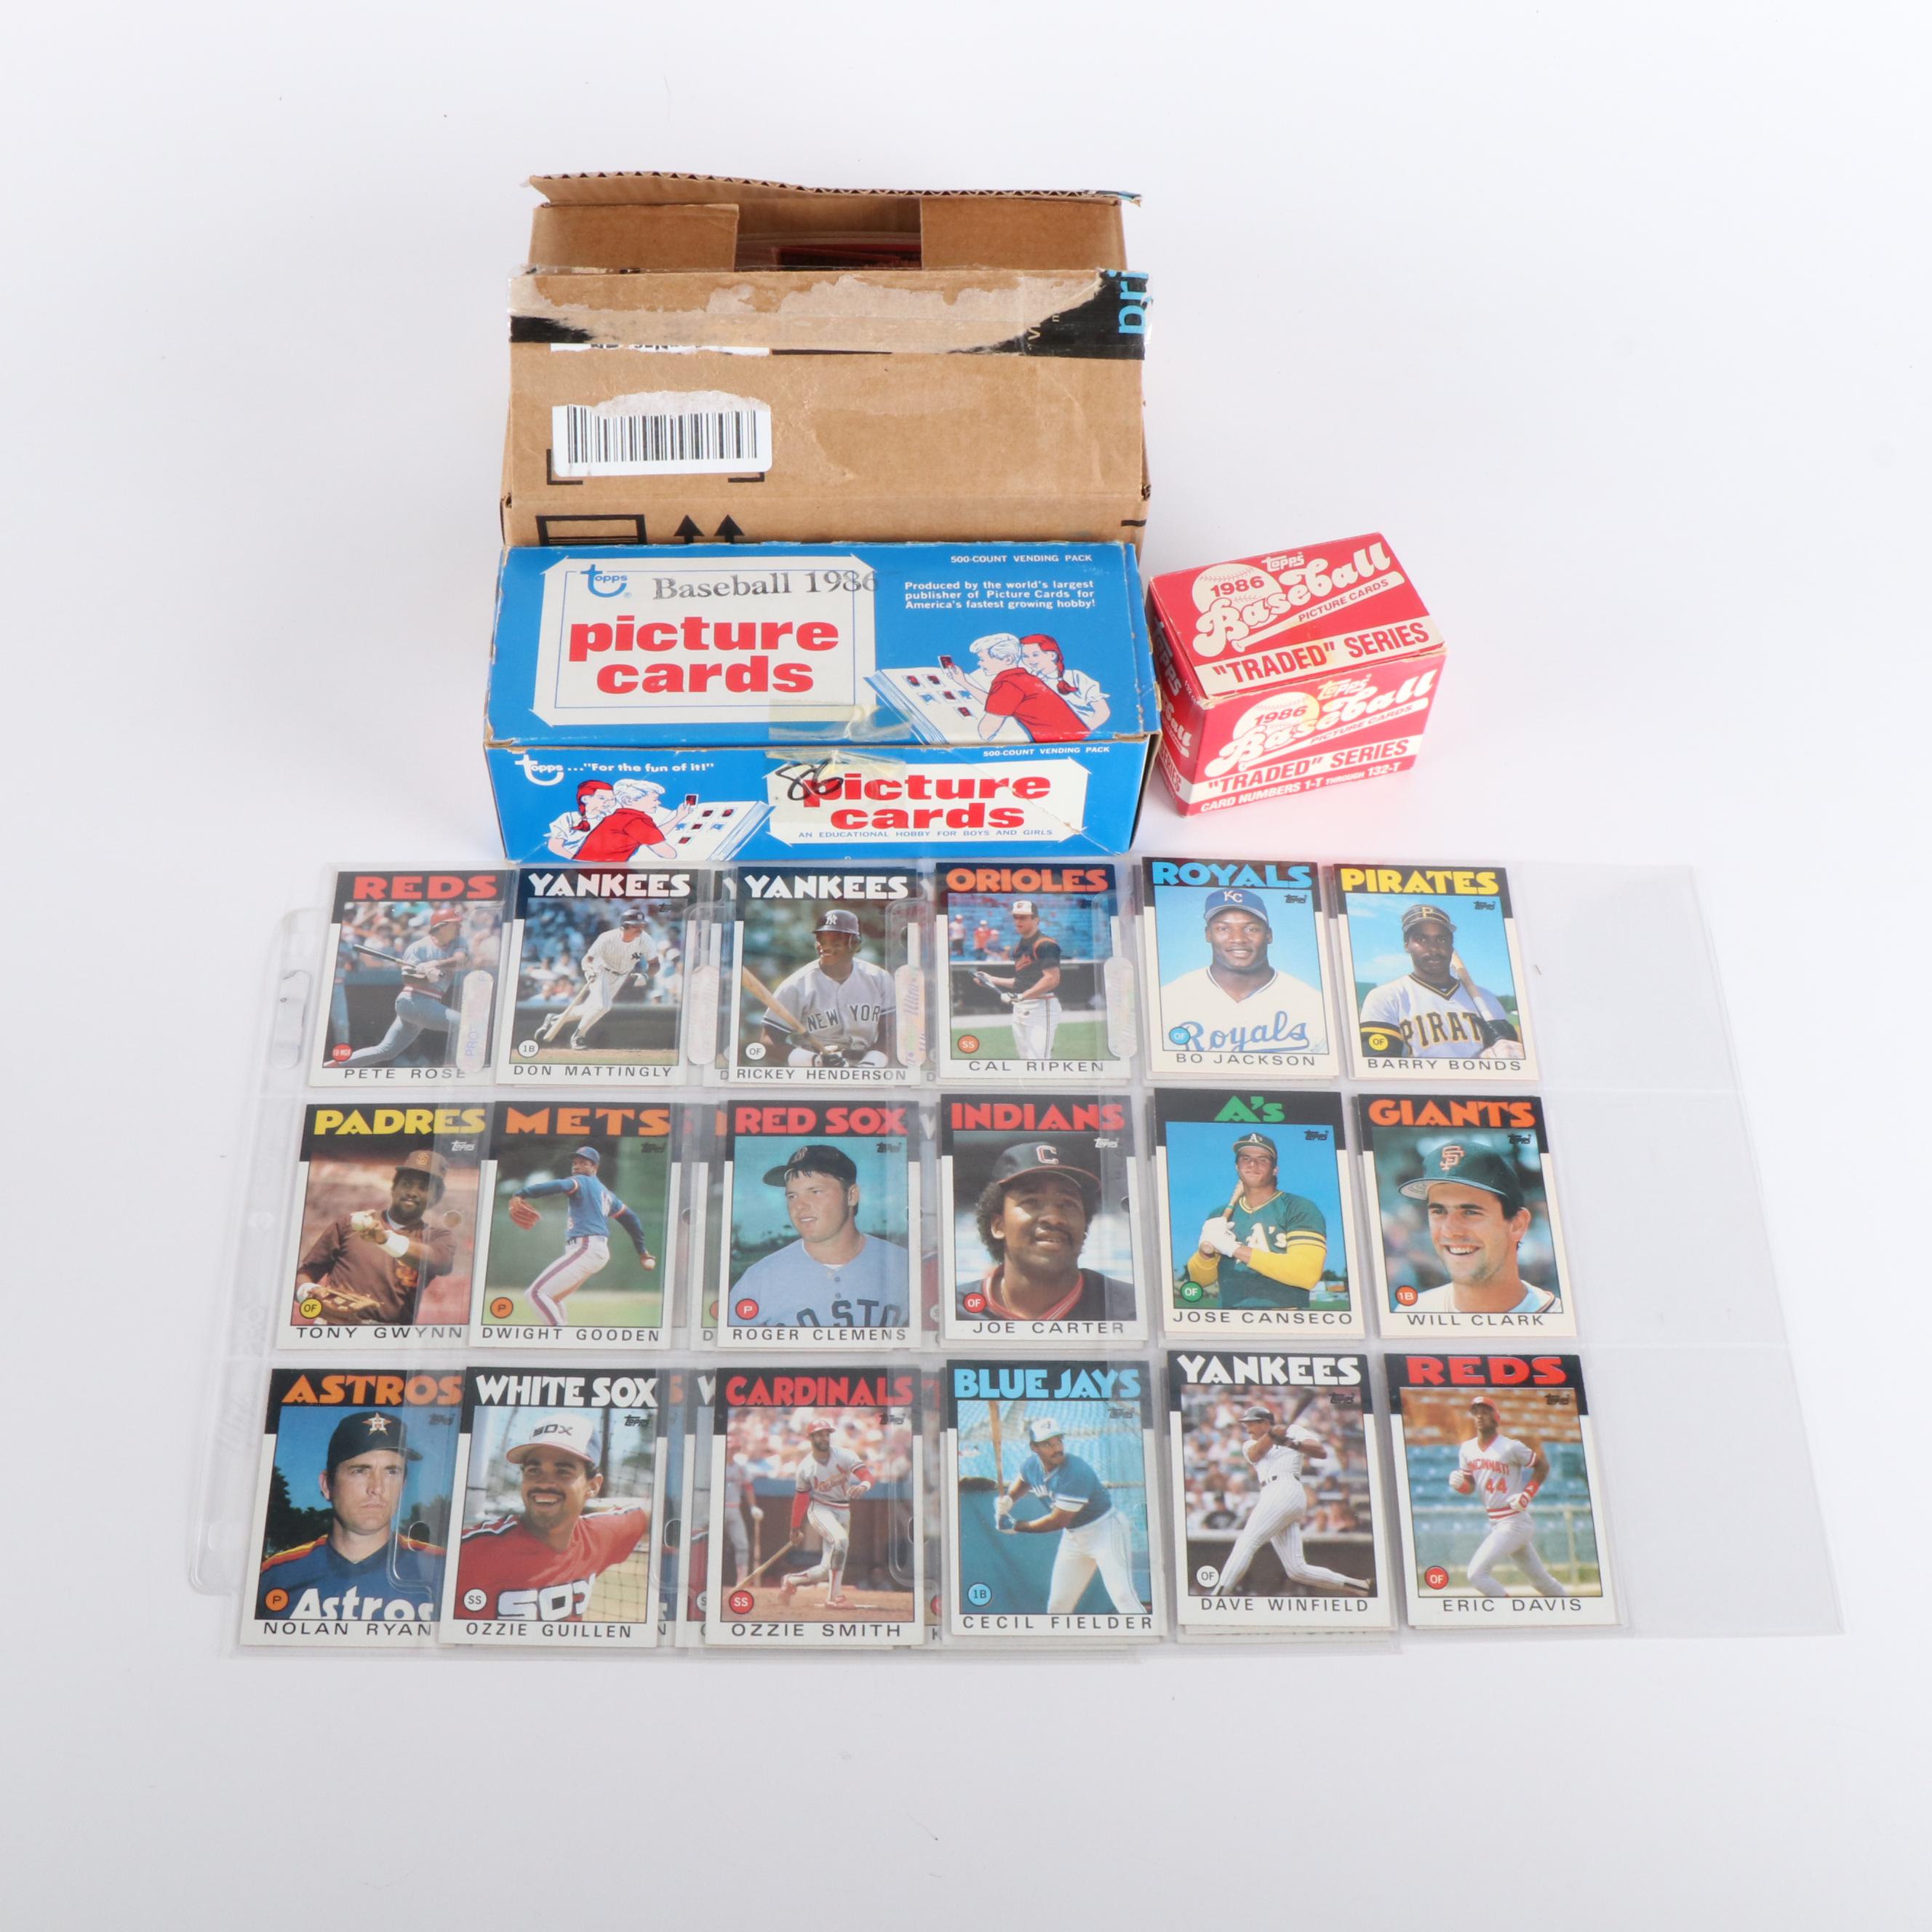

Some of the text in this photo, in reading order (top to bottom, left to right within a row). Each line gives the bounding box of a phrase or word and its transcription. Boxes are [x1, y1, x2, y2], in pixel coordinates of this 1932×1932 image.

[951, 555, 1007, 563] 500-COUNT
[652, 569, 879, 600] Baseball 1986
[905, 581, 960, 590] Produced
[965, 581, 978, 590] by
[983, 581, 1002, 589] the
[1053, 580, 1094, 590] largest
[1210, 575, 1264, 597] 1986
[905, 590, 1094, 601] publisher of Picture Cards for
[1192, 542, 1391, 658] Baseball
[1298, 579, 1389, 623] PICTURE CARDS
[905, 599, 1095, 610] America's fastest growing hobby!
[569, 615, 839, 662] picture
[1213, 641, 1334, 683] "TRADED"
[1344, 623, 1429, 658] SERIES
[596, 655, 814, 694] cards
[1204, 668, 1437, 778] Baseball
[1254, 706, 1307, 726] 1986
[1310, 705, 1413, 744] PICTURE CARDS
[983, 746, 1110, 757] 500-COUNT VENDING PACK
[618, 763, 642, 772] the
[645, 763, 668, 773] fun
[671, 763, 687, 772] of
[1209, 758, 1322, 793] "TRADED"
[1330, 740, 1409, 768] SERIES
[775, 759, 844, 800] 86
[802, 773, 1051, 807] picture
[1200, 762, 1402, 813] CARD NUMBERS 1-T THROUGH 132-T
[830, 802, 1025, 830] cards
[946, 868, 1108, 893] ORIOLES
[1151, 862, 1312, 888] ROYALS
[1341, 869, 1498, 894] PIRATES
[353, 875, 498, 901] REDS
[527, 874, 690, 897] YANKEES
[744, 875, 908, 899] YANKEES
[807, 1009, 839, 1032] NEW
[1186, 1010, 1309, 1052] Royals
[749, 1047, 762, 1055] OF
[962, 1040, 975, 1048] SS
[968, 1061, 1103, 1072] CAL RIPKEN
[1176, 1053, 1315, 1066] BO JACKSON
[1368, 1059, 1522, 1071] BARRY BONDS
[345, 1068, 467, 1079] PETE ROSE
[514, 1066, 671, 1077] DON MATTINGLY
[736, 1068, 906, 1080] RICKEY HENDERSON
[505, 1107, 671, 1135] METS
[735, 1107, 816, 1134] RED
[825, 1107, 907, 1135] SOX
[951, 1103, 1125, 1130] INDIANS
[1368, 1101, 1535, 1127] GIANTS
[314, 1109, 487, 1135] PADRES
[1037, 1145, 1059, 1164] C
[1184, 1288, 1198, 1296] OF
[1399, 1293, 1413, 1301] 1B
[303, 1304, 317, 1312] OF
[498, 1304, 506, 1312] P
[967, 1298, 981, 1307] OF
[744, 1306, 752, 1314] P
[1173, 1312, 1353, 1325] JOSE CANSECO
[1408, 1314, 1544, 1325] WILL CLARK
[296, 1328, 463, 1338] TONY GWYNN
[482, 1328, 659, 1341] DWIGHT GOODEN
[733, 1329, 906, 1341] ROGER CLEMENS
[973, 1322, 1124, 1334] JOE CARTER
[1177, 1354, 1361, 1385] YANKEES
[1406, 1356, 1567, 1384] REDS
[281, 1374, 463, 1405] ASTROS
[476, 1374, 584, 1407] WHITE
[591, 1378, 658, 1408] SOX
[954, 1368, 1048, 1399] BLUE
[1054, 1370, 1141, 1400] JAYS
[726, 1376, 913, 1407] CARDINALS
[1485, 1477, 1507, 1494] 44
[1201, 1572, 1215, 1581] OF
[1430, 1575, 1443, 1584] OF
[273, 1596, 282, 1605] P
[468, 1595, 482, 1604] SS
[973, 1589, 986, 1599] 1B
[734, 1597, 748, 1606] SS
[1200, 1598, 1368, 1612] DAVE WINFIELD
[1442, 1599, 1582, 1611] ERIC DAVIS
[263, 1622, 431, 1637] NOLAN RYAN
[962, 1616, 1152, 1630] CECIL FIELDER
[466, 1624, 631, 1638] OZZIE GUILLEN
[731, 1624, 901, 1637] OZZIE SMITH
